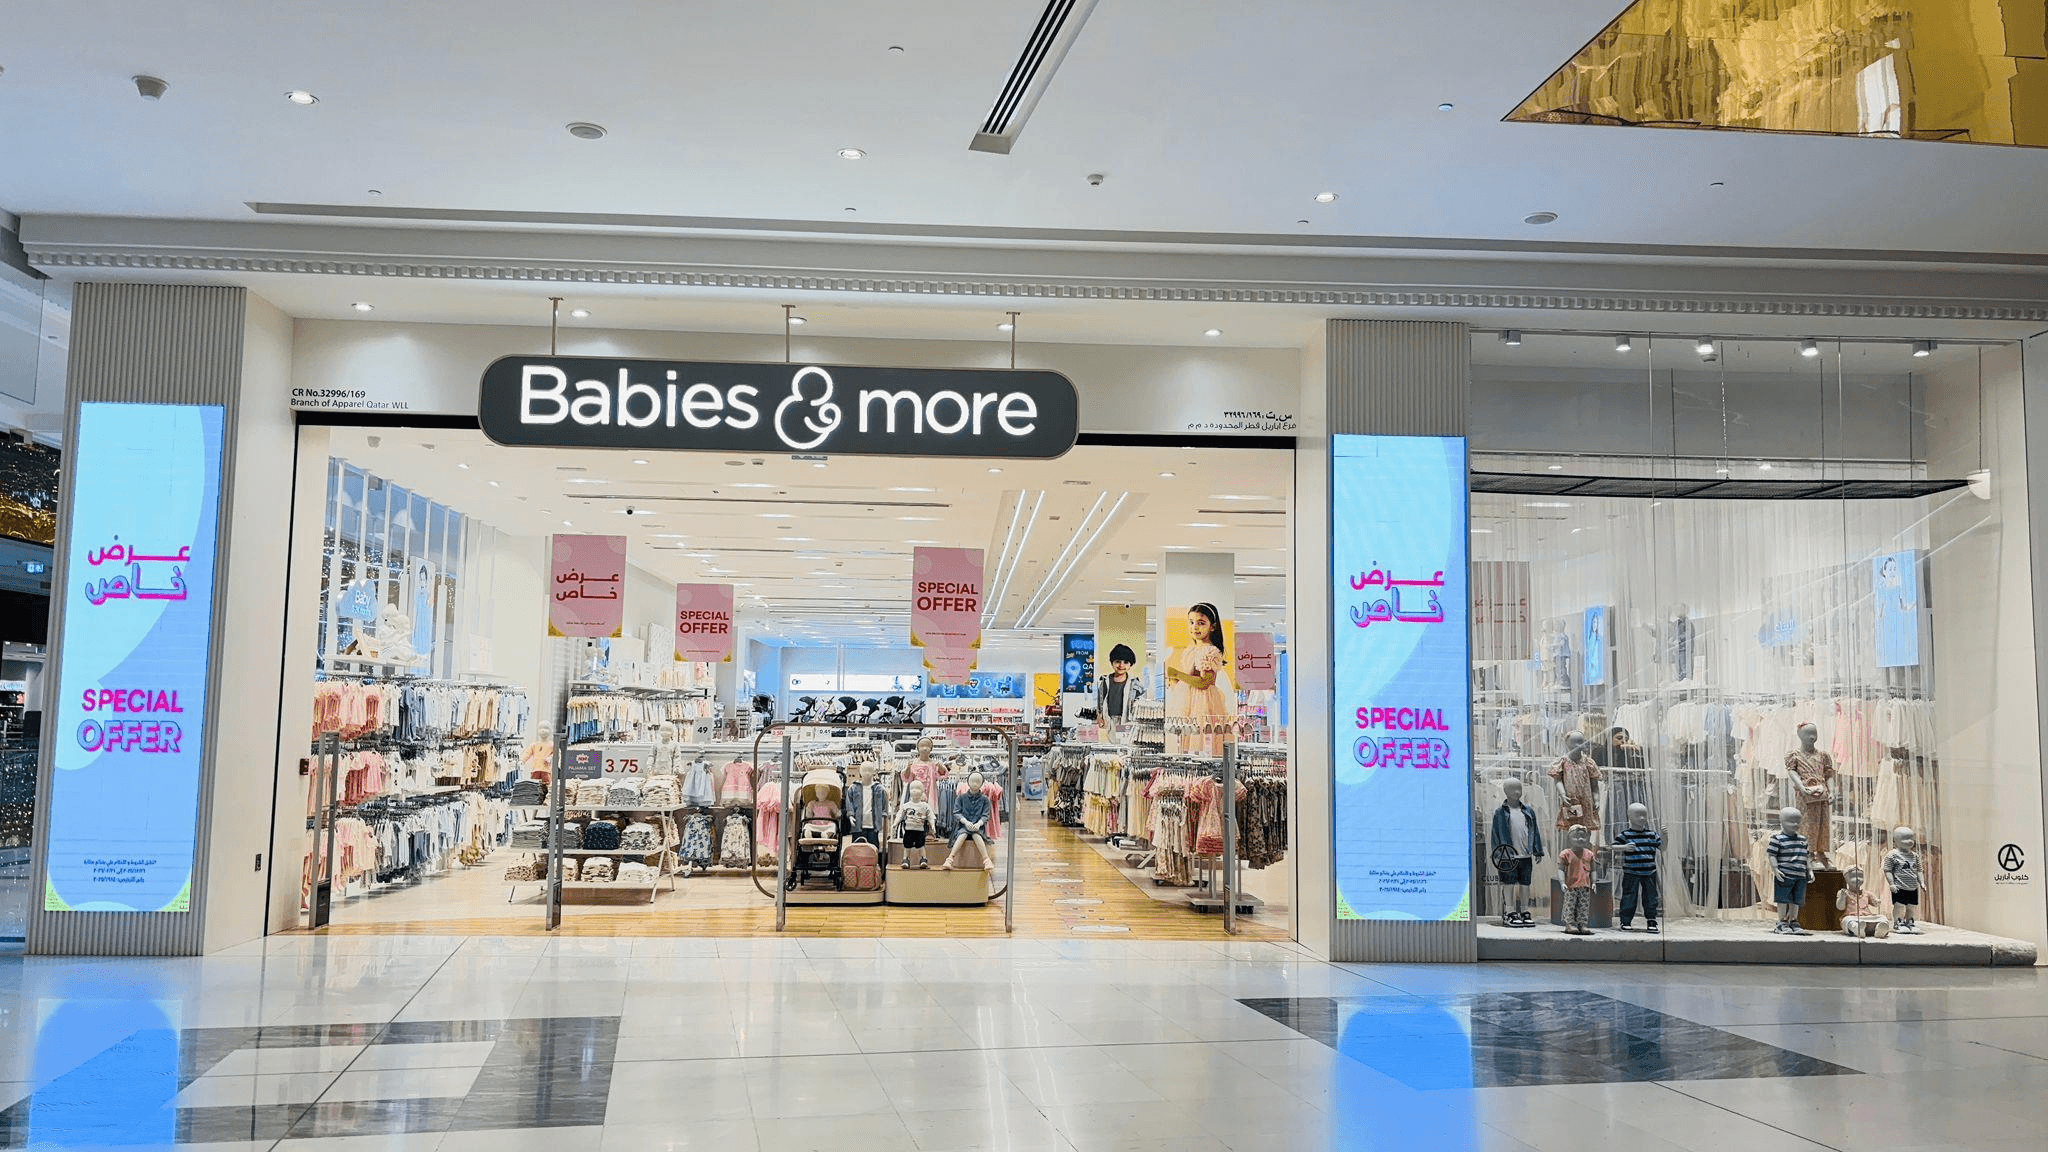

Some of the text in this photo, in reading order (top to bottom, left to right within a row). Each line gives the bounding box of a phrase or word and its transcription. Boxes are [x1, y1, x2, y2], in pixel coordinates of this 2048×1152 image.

[292, 388, 366, 398] CR No.32996/169
[290, 398, 409, 409] Branch of Apparel Qatar WLL
[520, 364, 1038, 450] Babies & more
[1243, 421, 1260, 431] قطر
[1283, 421, 1297, 430] فرع
[88, 534, 190, 567] عرض
[556, 568, 620, 584] عرض
[1350, 560, 1445, 591] عرض
[85, 563, 188, 606] خاص
[556, 584, 618, 601] خاص
[918, 581, 979, 595] SPECIAL
[917, 596, 977, 612] OFFER
[1350, 586, 1444, 628] خاص
[680, 610, 730, 621] SPECIAL
[679, 622, 729, 634] OFFER
[1237, 651, 1272, 660] عرض
[1238, 661, 1272, 671] خاص
[82, 689, 184, 713] SPECIAL
[1355, 706, 1449, 731] SPECIAL
[77, 719, 183, 753] OFFER
[1353, 735, 1450, 769] OFFER
